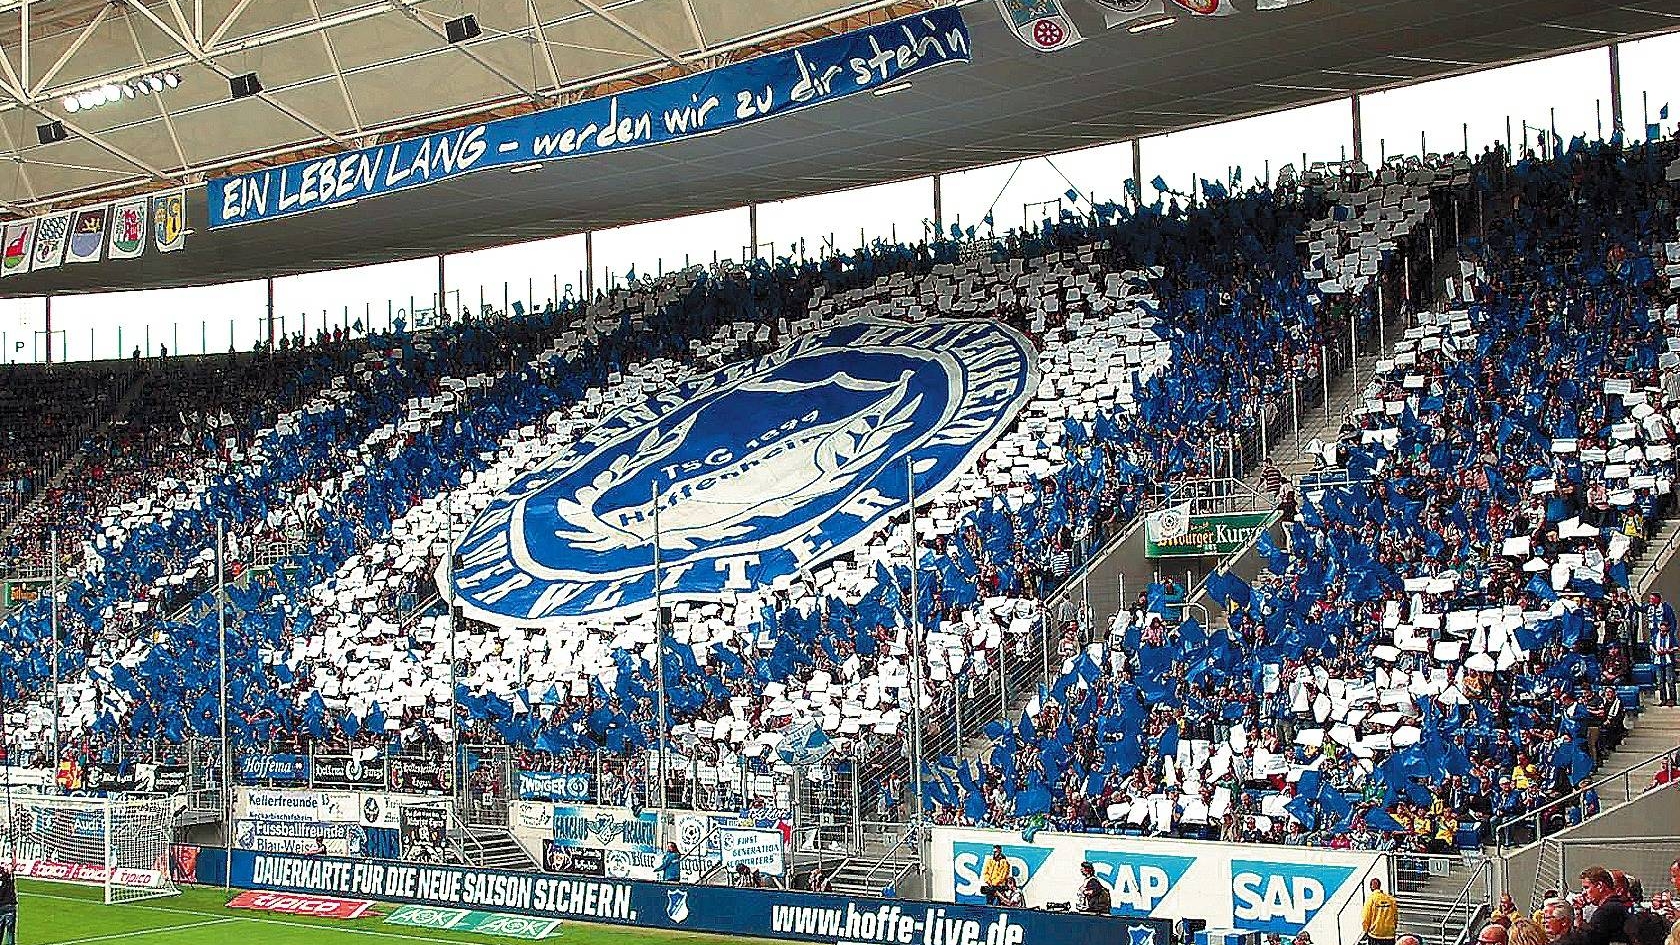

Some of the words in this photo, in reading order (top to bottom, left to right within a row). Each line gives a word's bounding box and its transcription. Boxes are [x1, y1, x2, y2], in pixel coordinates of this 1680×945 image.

[222, 179, 271, 220] EIN
[278, 145, 384, 211] LEBEN
[386, 123, 490, 182] LANG
[532, 97, 651, 158] werden
[664, 95, 720, 135] wir
[735, 83, 772, 119] zu
[790, 49, 843, 102] dir
[15, 340, 25, 353] P
[745, 409, 820, 450] 1899
[249, 793, 318, 808] Kellerfreunde
[256, 820, 346, 839] Fussballfreunde
[253, 854, 350, 892] DAUERKARTE
[352, 858, 385, 896] FÜR
[386, 866, 416, 900] DIE
[416, 868, 461, 903] NEUE
[462, 872, 533, 910] SAISON
[533, 877, 637, 921] SICHERN.
[954, 852, 1030, 897] SP
[251, 891, 341, 913] tipico
[1233, 870, 1326, 924] SAP
[771, 902, 1024, 945] www.hoffe-live.de
